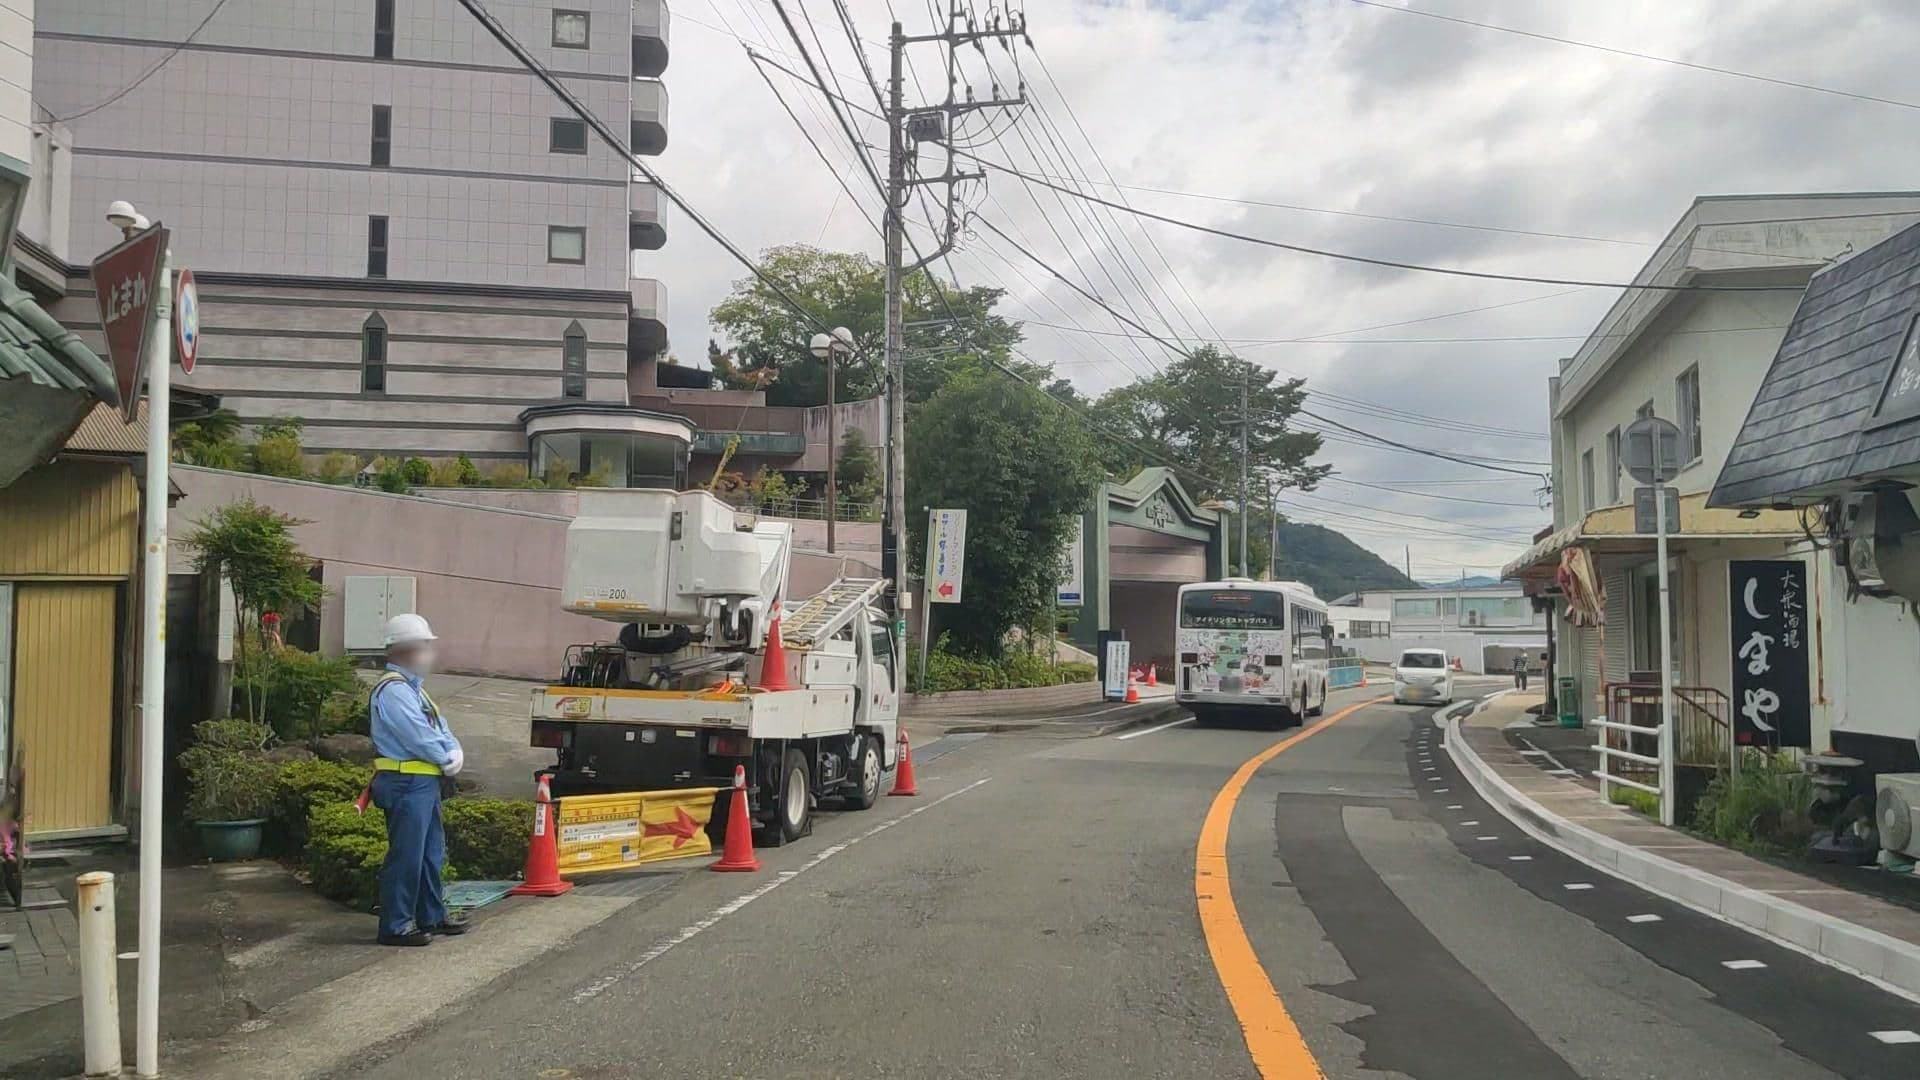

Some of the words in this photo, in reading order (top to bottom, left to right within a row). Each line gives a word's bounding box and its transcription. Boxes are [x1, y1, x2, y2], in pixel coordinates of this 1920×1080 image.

[105, 272, 147, 324] 止まれ
[1779, 569, 1803, 649] 大衆酒場
[1738, 577, 1780, 732] しまや
